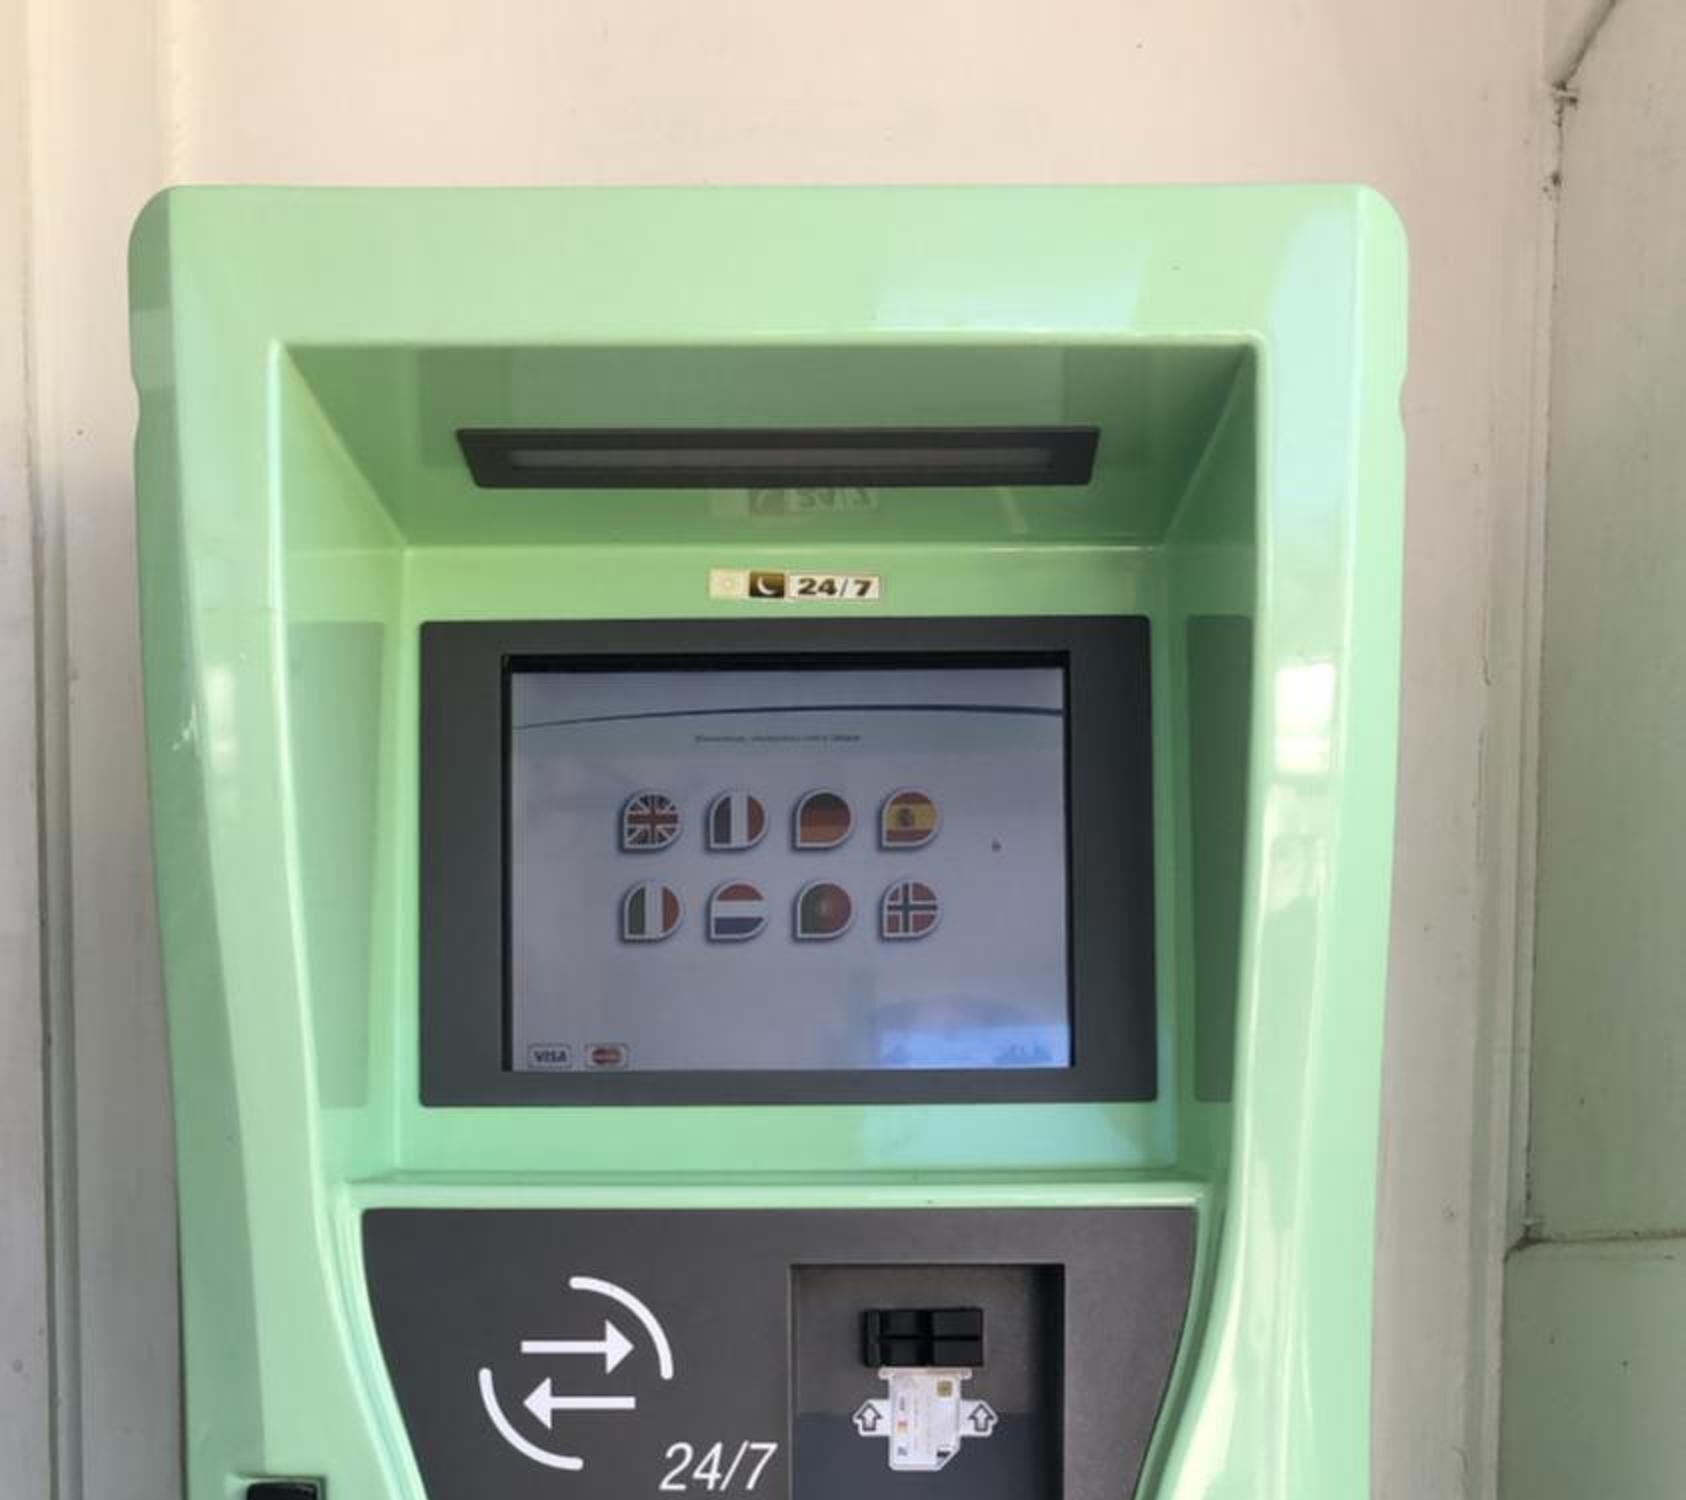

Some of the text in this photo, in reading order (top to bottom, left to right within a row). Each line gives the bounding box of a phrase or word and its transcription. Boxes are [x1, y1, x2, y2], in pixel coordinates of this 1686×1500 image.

[797, 577, 872, 597] 24/7
[533, 1050, 567, 1063] VISA
[659, 1440, 778, 1491] 24/7
